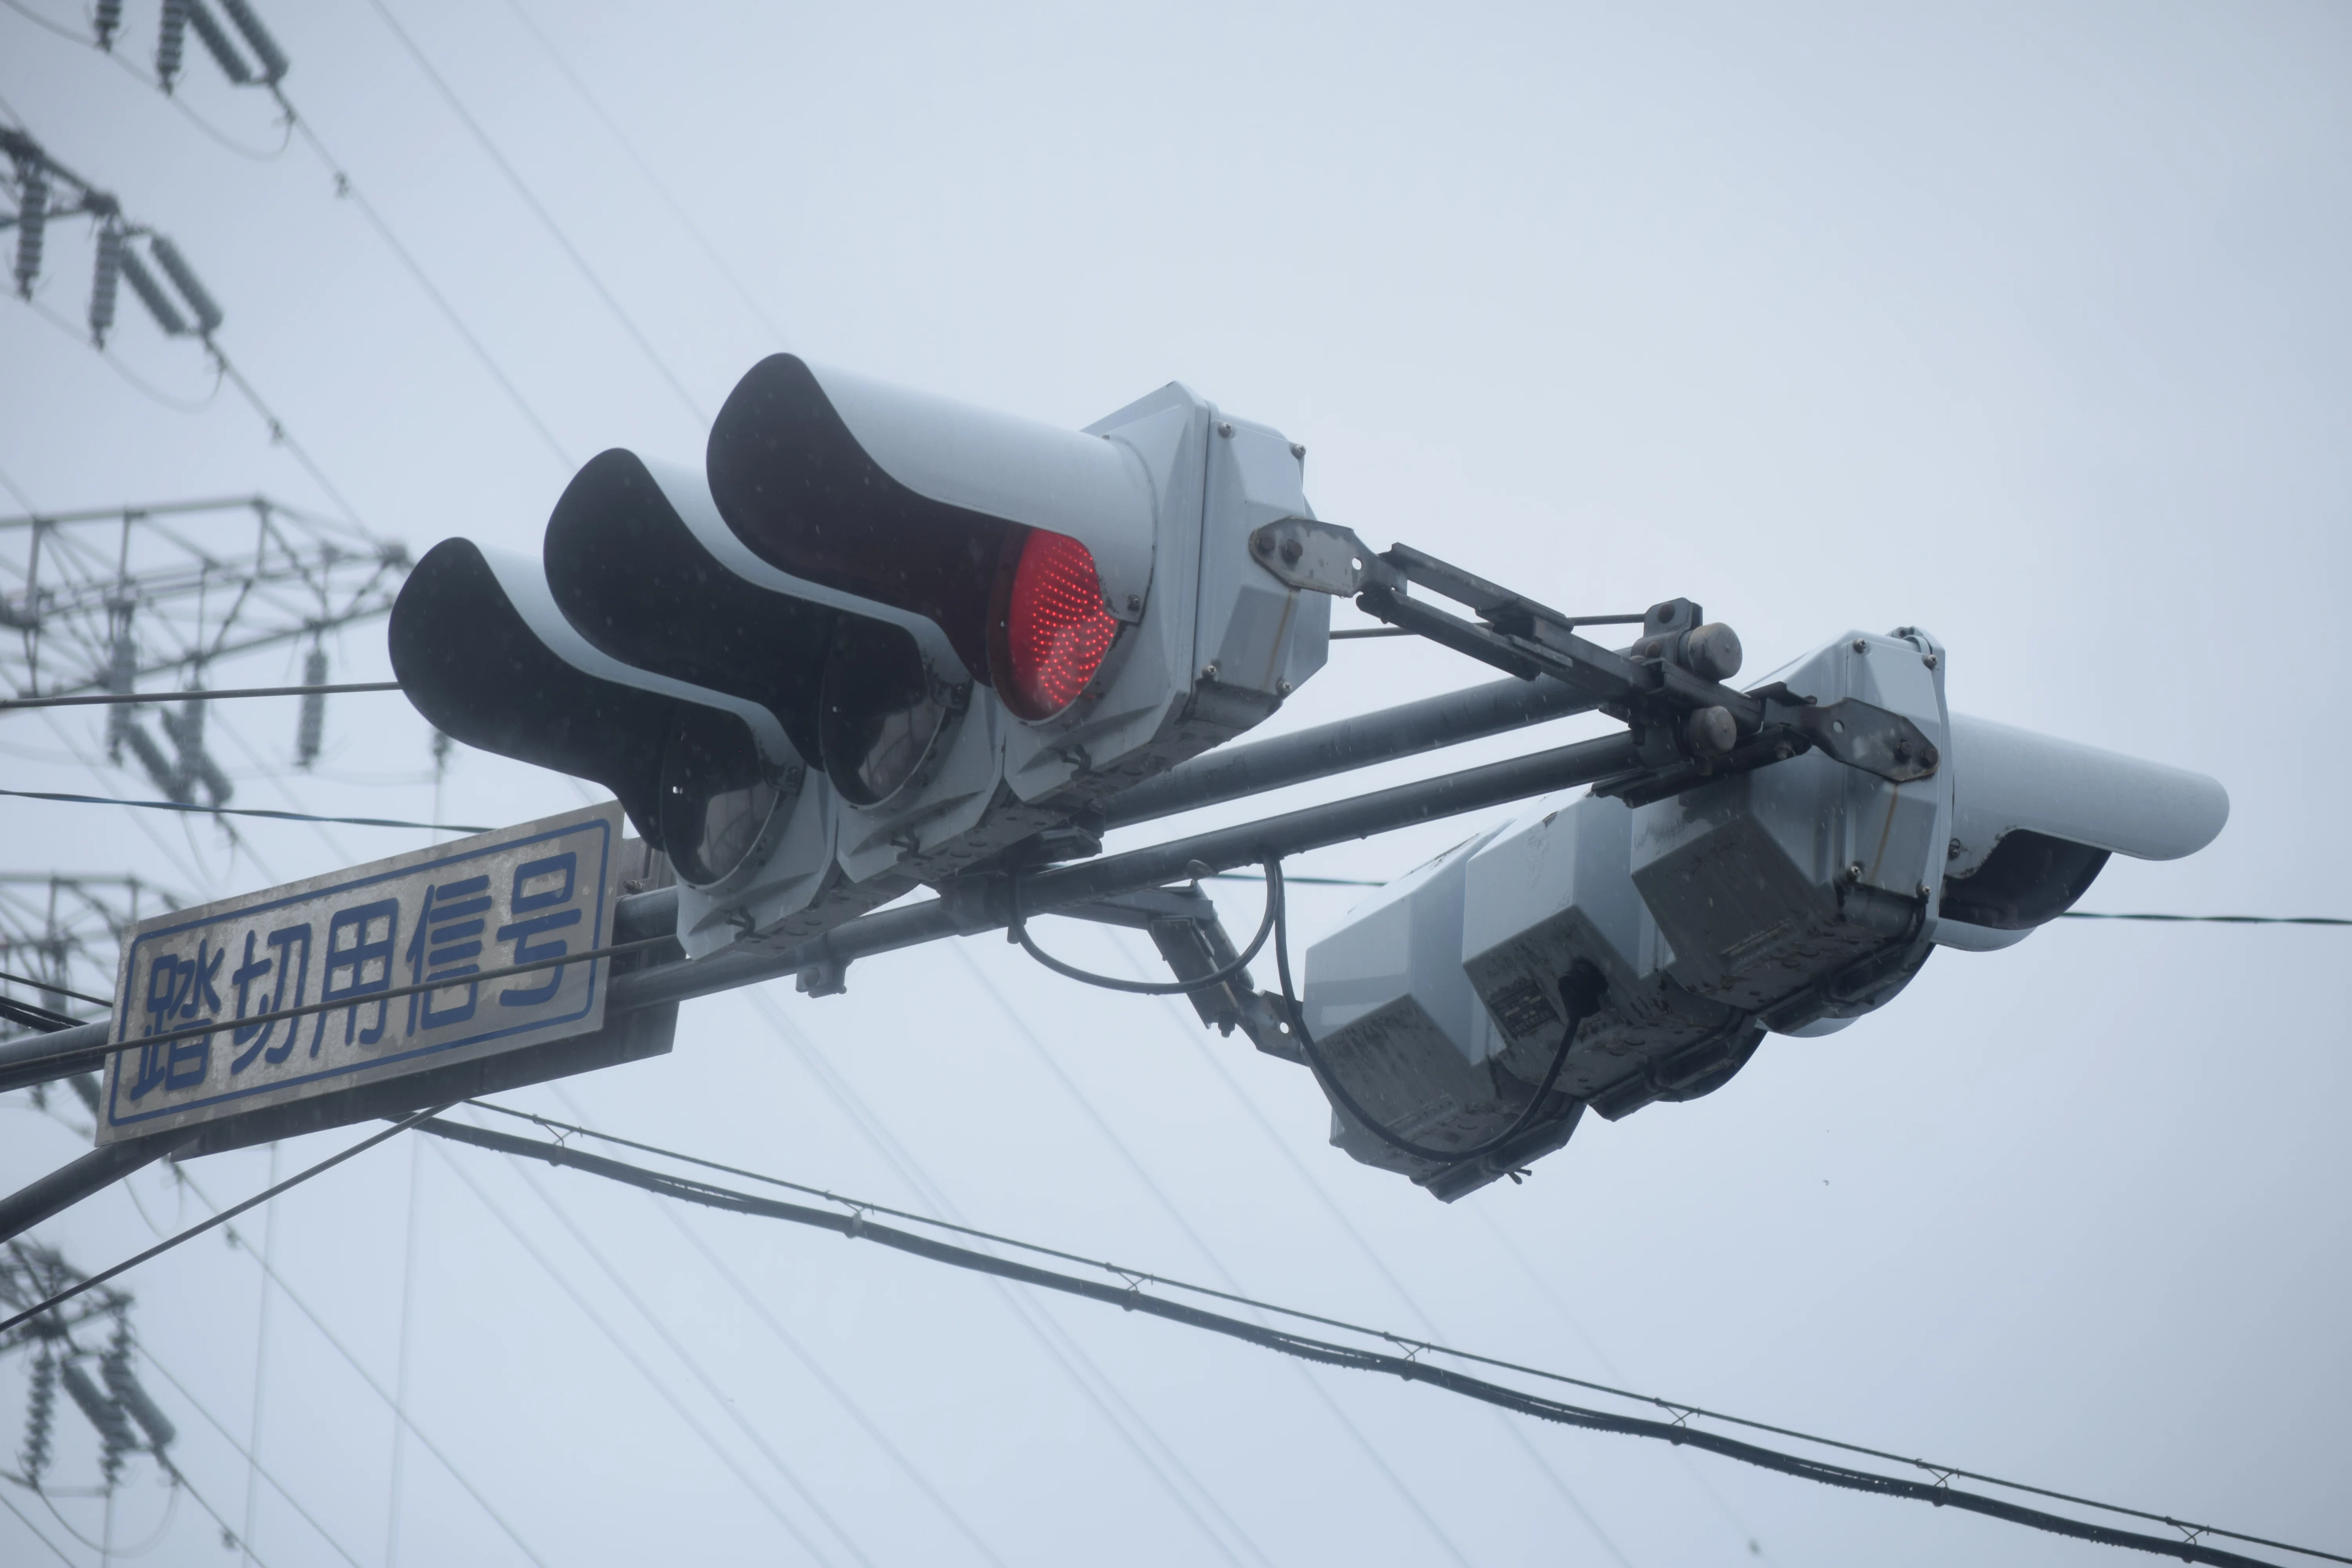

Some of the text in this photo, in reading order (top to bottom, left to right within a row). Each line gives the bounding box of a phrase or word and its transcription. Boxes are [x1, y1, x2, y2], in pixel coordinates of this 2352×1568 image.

[130, 852, 582, 1100] 踏切用信号
